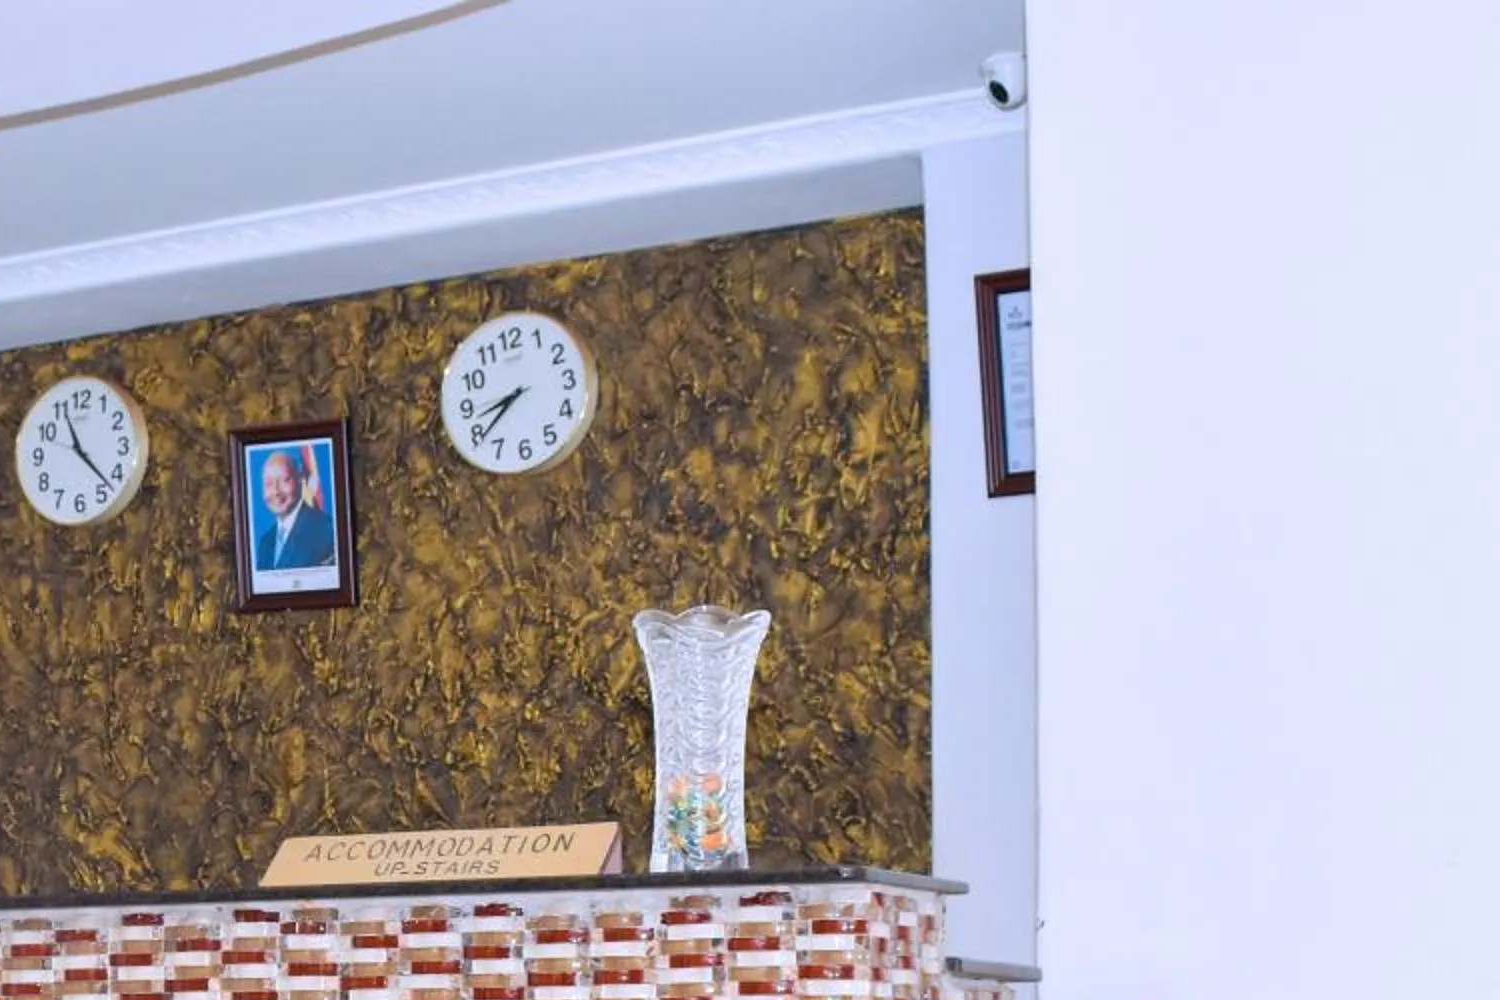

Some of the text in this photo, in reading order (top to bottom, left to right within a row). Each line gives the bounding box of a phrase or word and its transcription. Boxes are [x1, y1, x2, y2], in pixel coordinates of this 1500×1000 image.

[498, 327, 523, 350] 12
[532, 328, 541, 349] 1
[478, 344, 497, 366] 11
[551, 343, 565, 364] 2
[462, 369, 485, 391] 10
[562, 369, 576, 390] 3
[72, 388, 91, 410] 12
[98, 394, 107, 413] 1
[460, 399, 474, 419] 9
[559, 398, 573, 419] 4
[53, 400, 68, 420] 11
[112, 411, 124, 431] 2
[38, 422, 57, 442] 10
[471, 424, 485, 447] 8
[543, 424, 557, 446] 5
[117, 436, 129, 456] 3
[491, 438, 505, 460] 7
[518, 439, 532, 460] 6
[33, 448, 44, 467] 9
[39, 472, 49, 492] 8
[111, 463, 123, 482] 4
[53, 489, 65, 509] 7
[74, 494, 85, 513] 6
[95, 483, 108, 504] 5
[303, 831, 576, 863] ACCOMMODATION
